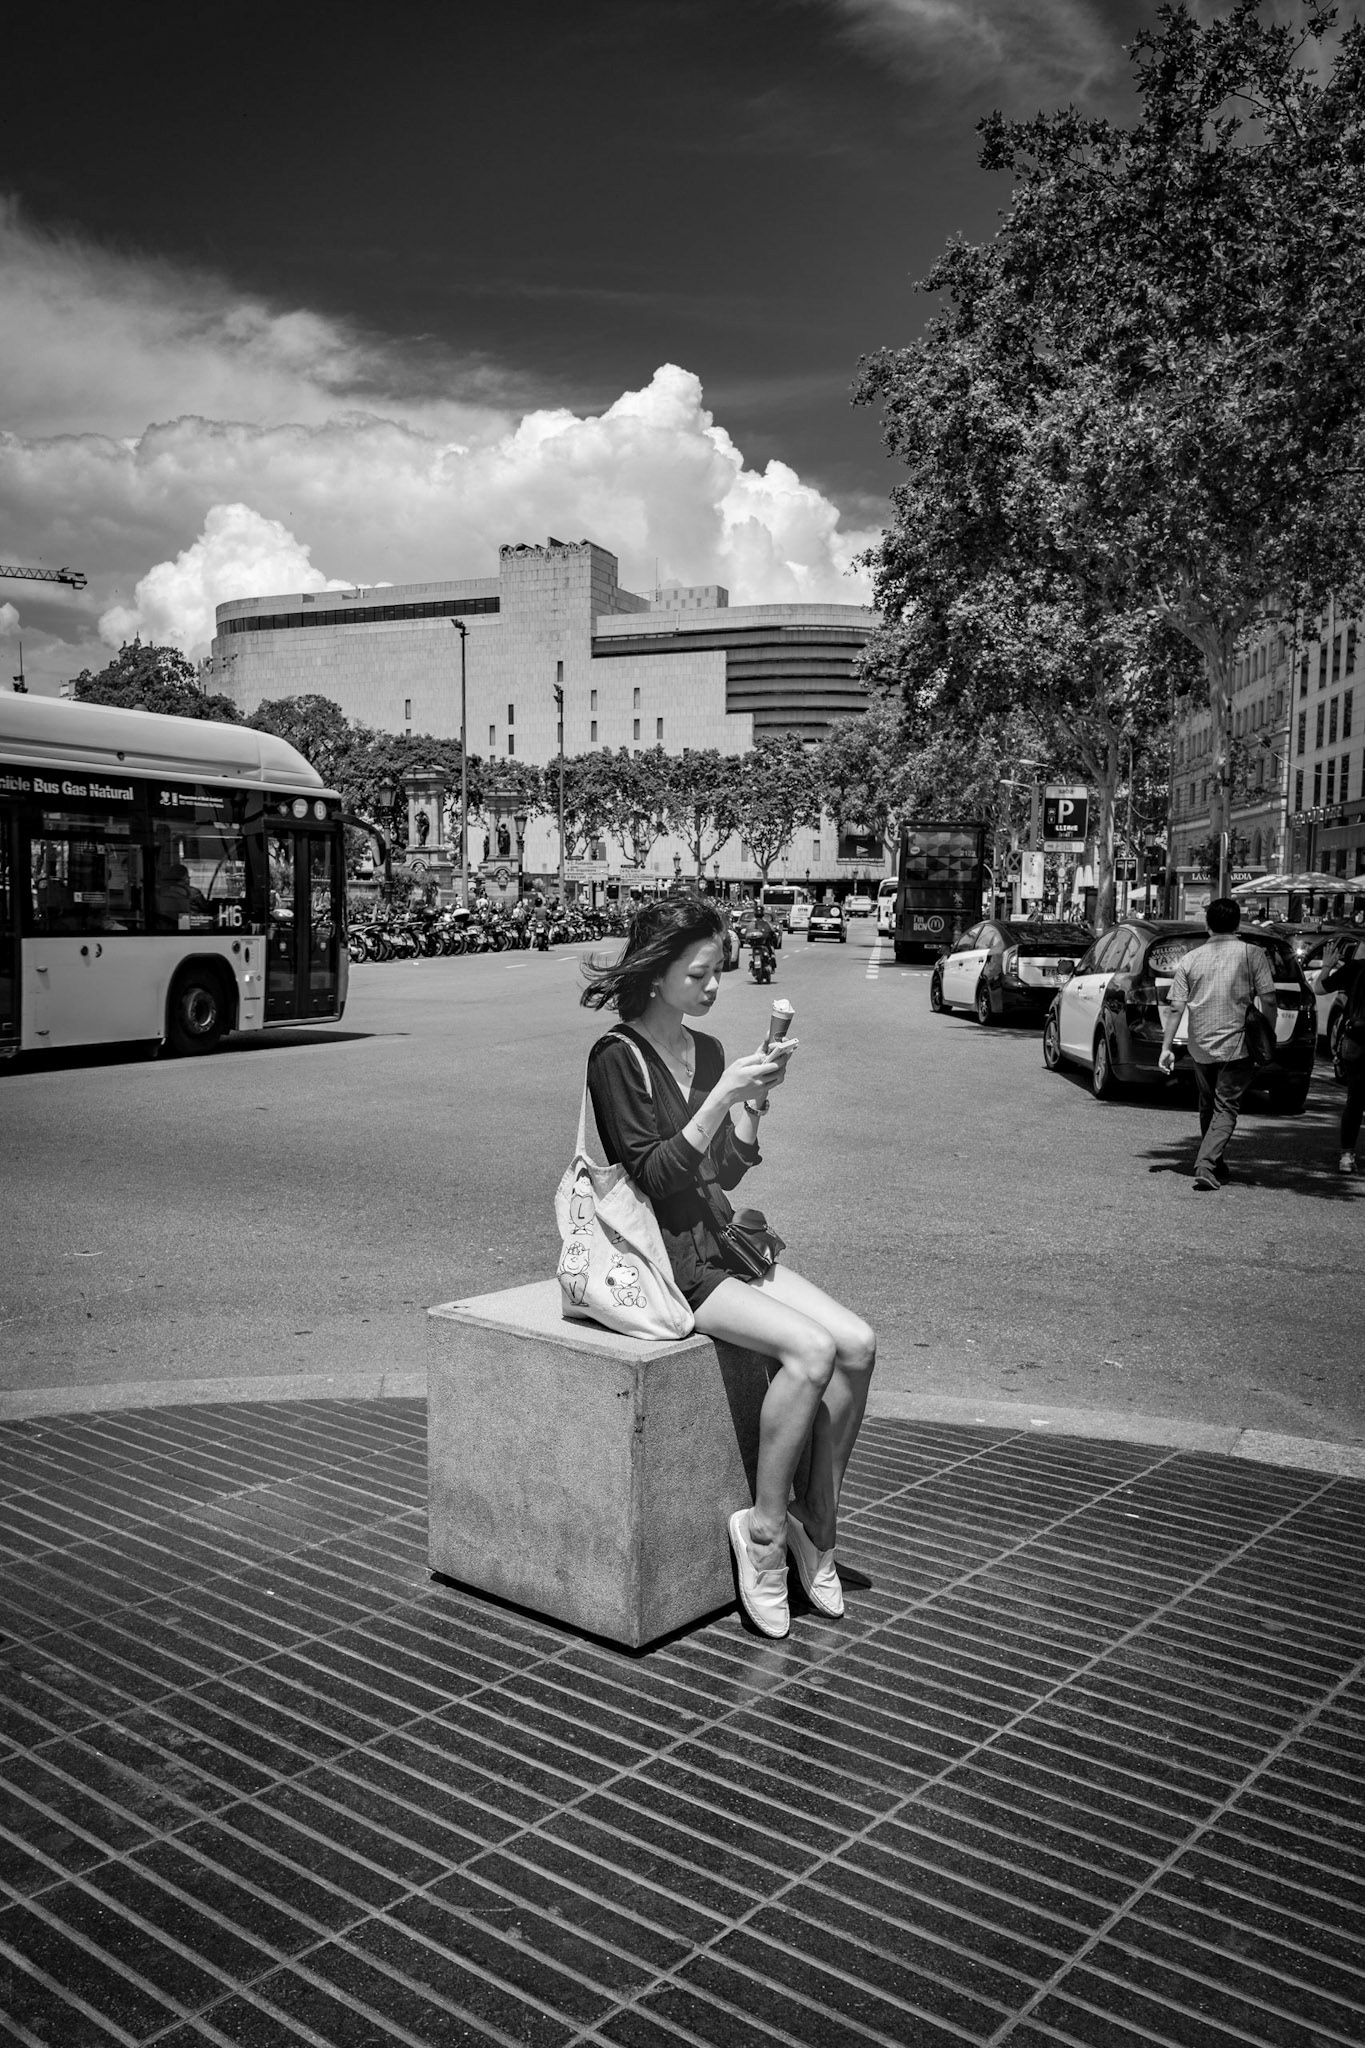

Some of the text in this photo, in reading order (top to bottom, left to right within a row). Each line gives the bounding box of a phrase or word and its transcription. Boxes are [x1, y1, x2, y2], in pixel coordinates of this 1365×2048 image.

[33, 777, 60, 794] Bus
[61, 780, 88, 796] Gas
[89, 783, 134, 800] Natural
[1058, 799, 1074, 824] P
[219, 904, 242, 927] H16
[913, 922, 928, 931] BCN
[577, 1202, 585, 1220] L
[568, 1280, 577, 1299] V
